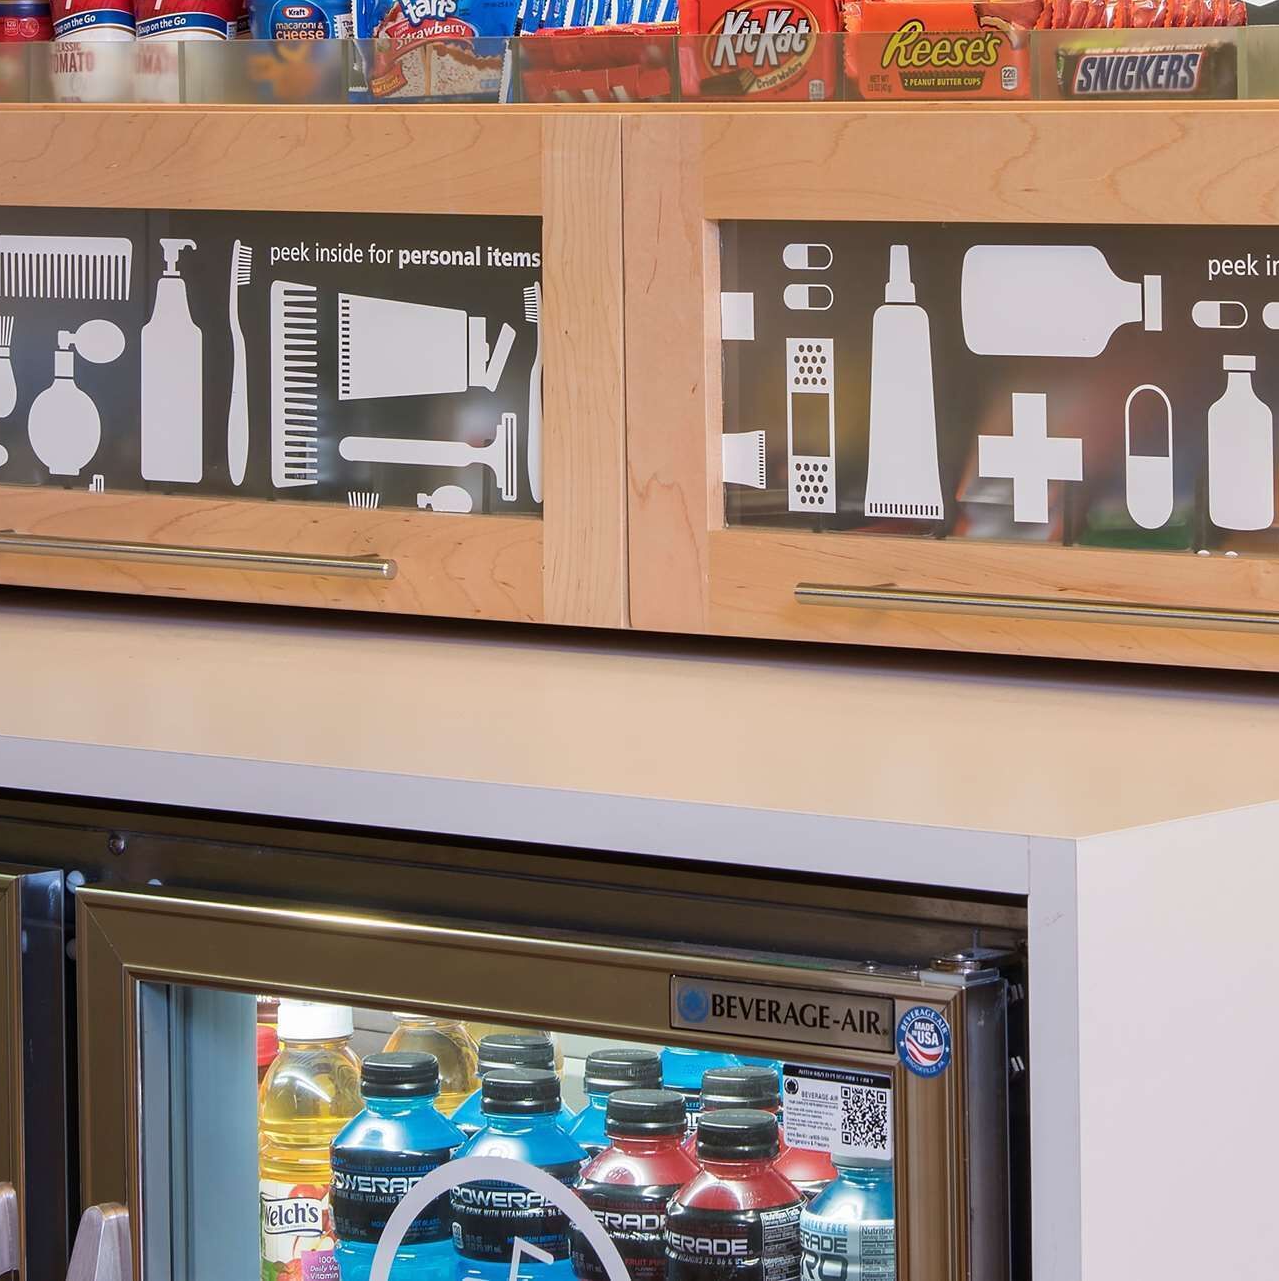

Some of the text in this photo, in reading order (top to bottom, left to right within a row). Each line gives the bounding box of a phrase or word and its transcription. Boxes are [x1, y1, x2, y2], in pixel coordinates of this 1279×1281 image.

[287, 9, 305, 17] Kraft
[72, 18, 83, 27] the
[84, 14, 96, 24] Go
[151, 22, 159, 30] on
[160, 19, 173, 28] the
[174, 16, 186, 26] Go
[275, 22, 325, 31] macaroni &
[395, 23, 466, 50] Strawberry
[882, 19, 1002, 68] Reese's
[1075, 54, 1201, 93] SNICKERS
[755, 73, 776, 90] Crisp
[904, 77, 982, 87] 2 PEANUT BUTTER CUPS
[270, 244, 310, 266] peek
[315, 241, 365, 265] inside
[368, 242, 394, 265] for
[398, 246, 481, 269] personal
[1208, 254, 1259, 280] peek
[712, 994, 882, 1036] BEVERAGE-AIR
[900, 1008, 949, 1035] BEVERAGE-AIR
[914, 1022, 934, 1032] MADE
[917, 1031, 938, 1045] USA
[365, 1194, 398, 1205] VITAMINS
[484, 1209, 499, 1217] WITH
[826, 1223, 848, 1233] FREE
[310, 1265, 328, 1274] Daily
[311, 1272, 339, 1281] Vitamin
